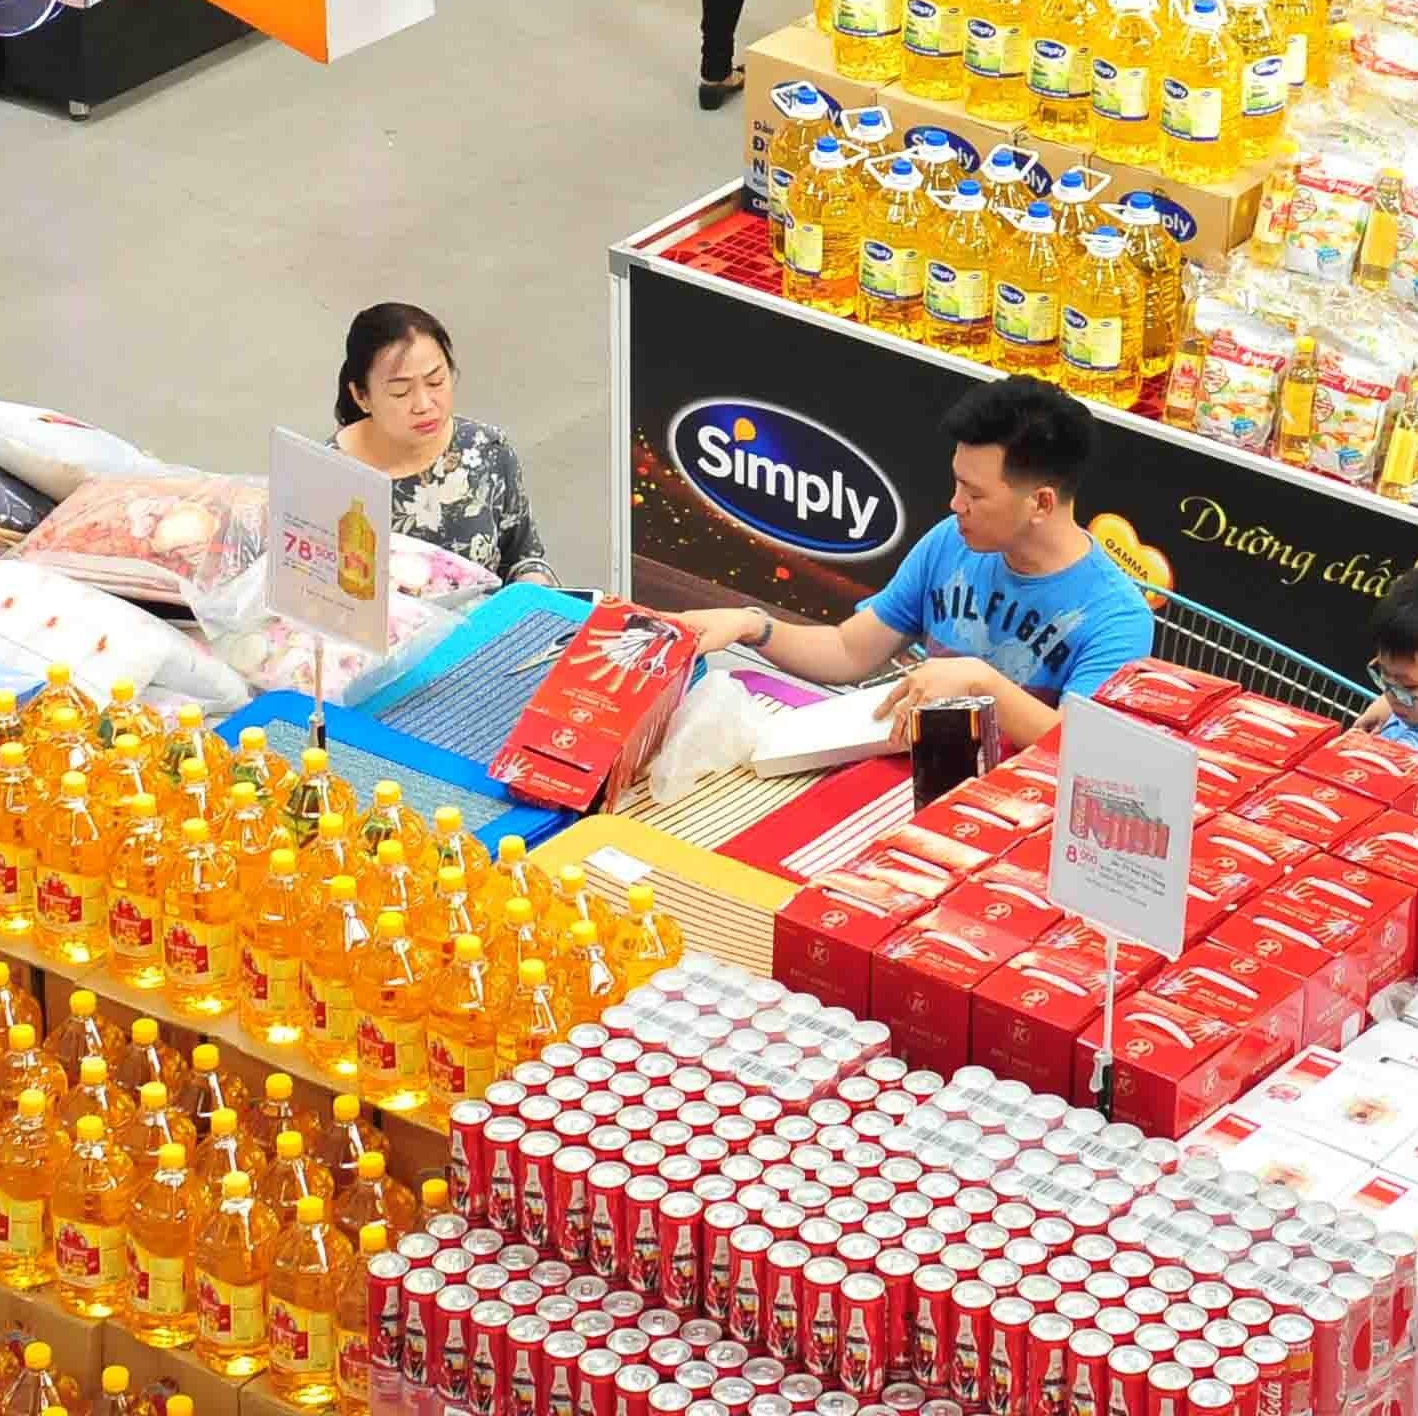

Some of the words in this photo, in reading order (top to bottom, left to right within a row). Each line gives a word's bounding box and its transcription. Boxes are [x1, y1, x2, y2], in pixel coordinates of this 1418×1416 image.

[694, 416, 881, 542] Simply
[283, 531, 312, 561] 78
[1105, 537, 1150, 581] GAMMA
[1181, 495, 1317, 586] Dưỡng
[1322, 539, 1401, 598] chấ
[931, 584, 1072, 674] HILFIGER
